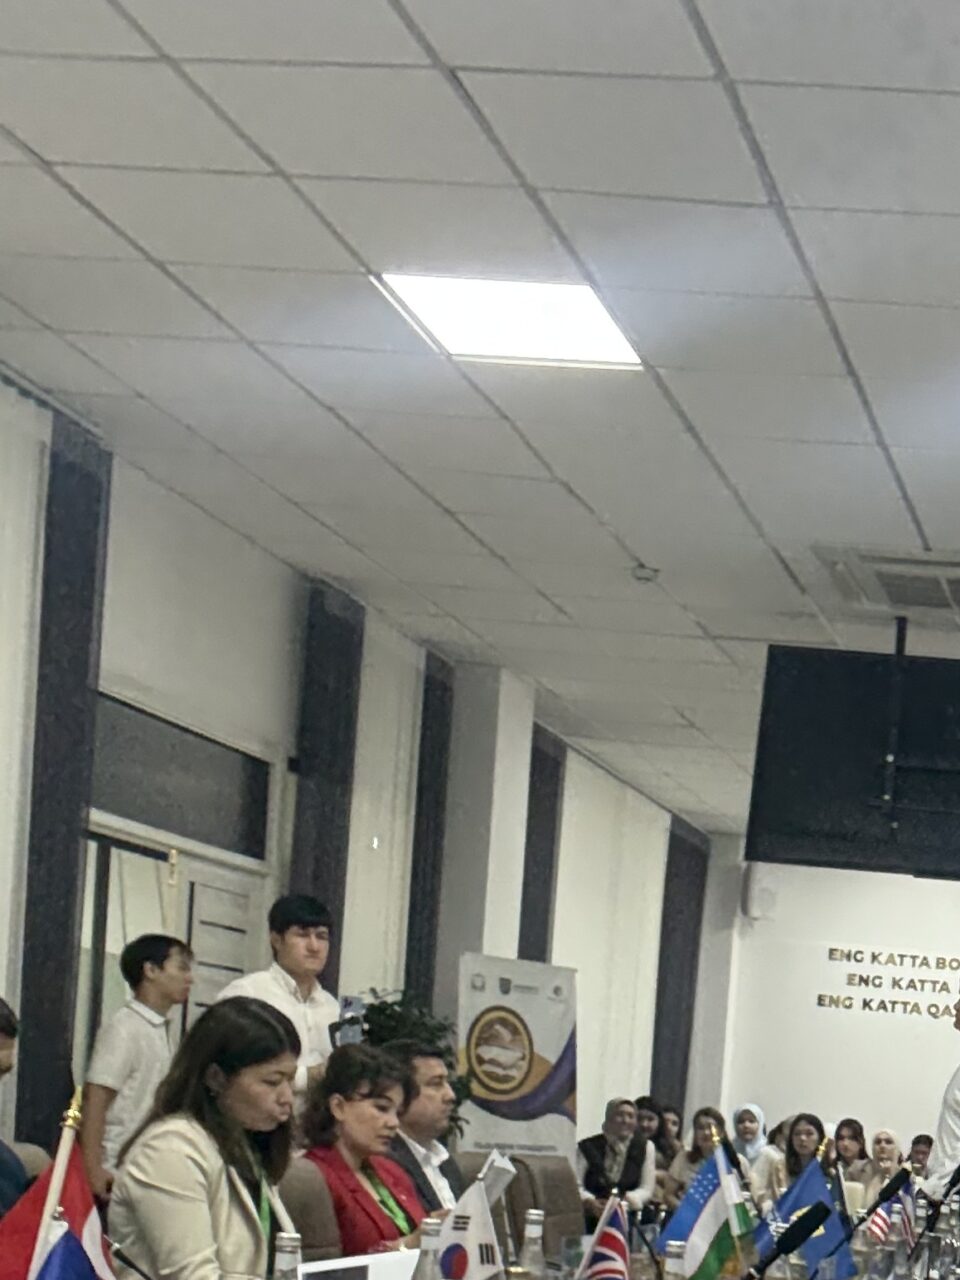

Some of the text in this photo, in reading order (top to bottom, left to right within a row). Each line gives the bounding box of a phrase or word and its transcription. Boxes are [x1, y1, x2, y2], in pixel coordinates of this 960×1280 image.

[828, 948, 865, 963] ENG
[871, 951, 931, 969] KATTA
[846, 973, 883, 988] ENG
[891, 976, 951, 994] KATTA
[817, 993, 853, 1009] ENG
[862, 998, 922, 1016] KATTA
